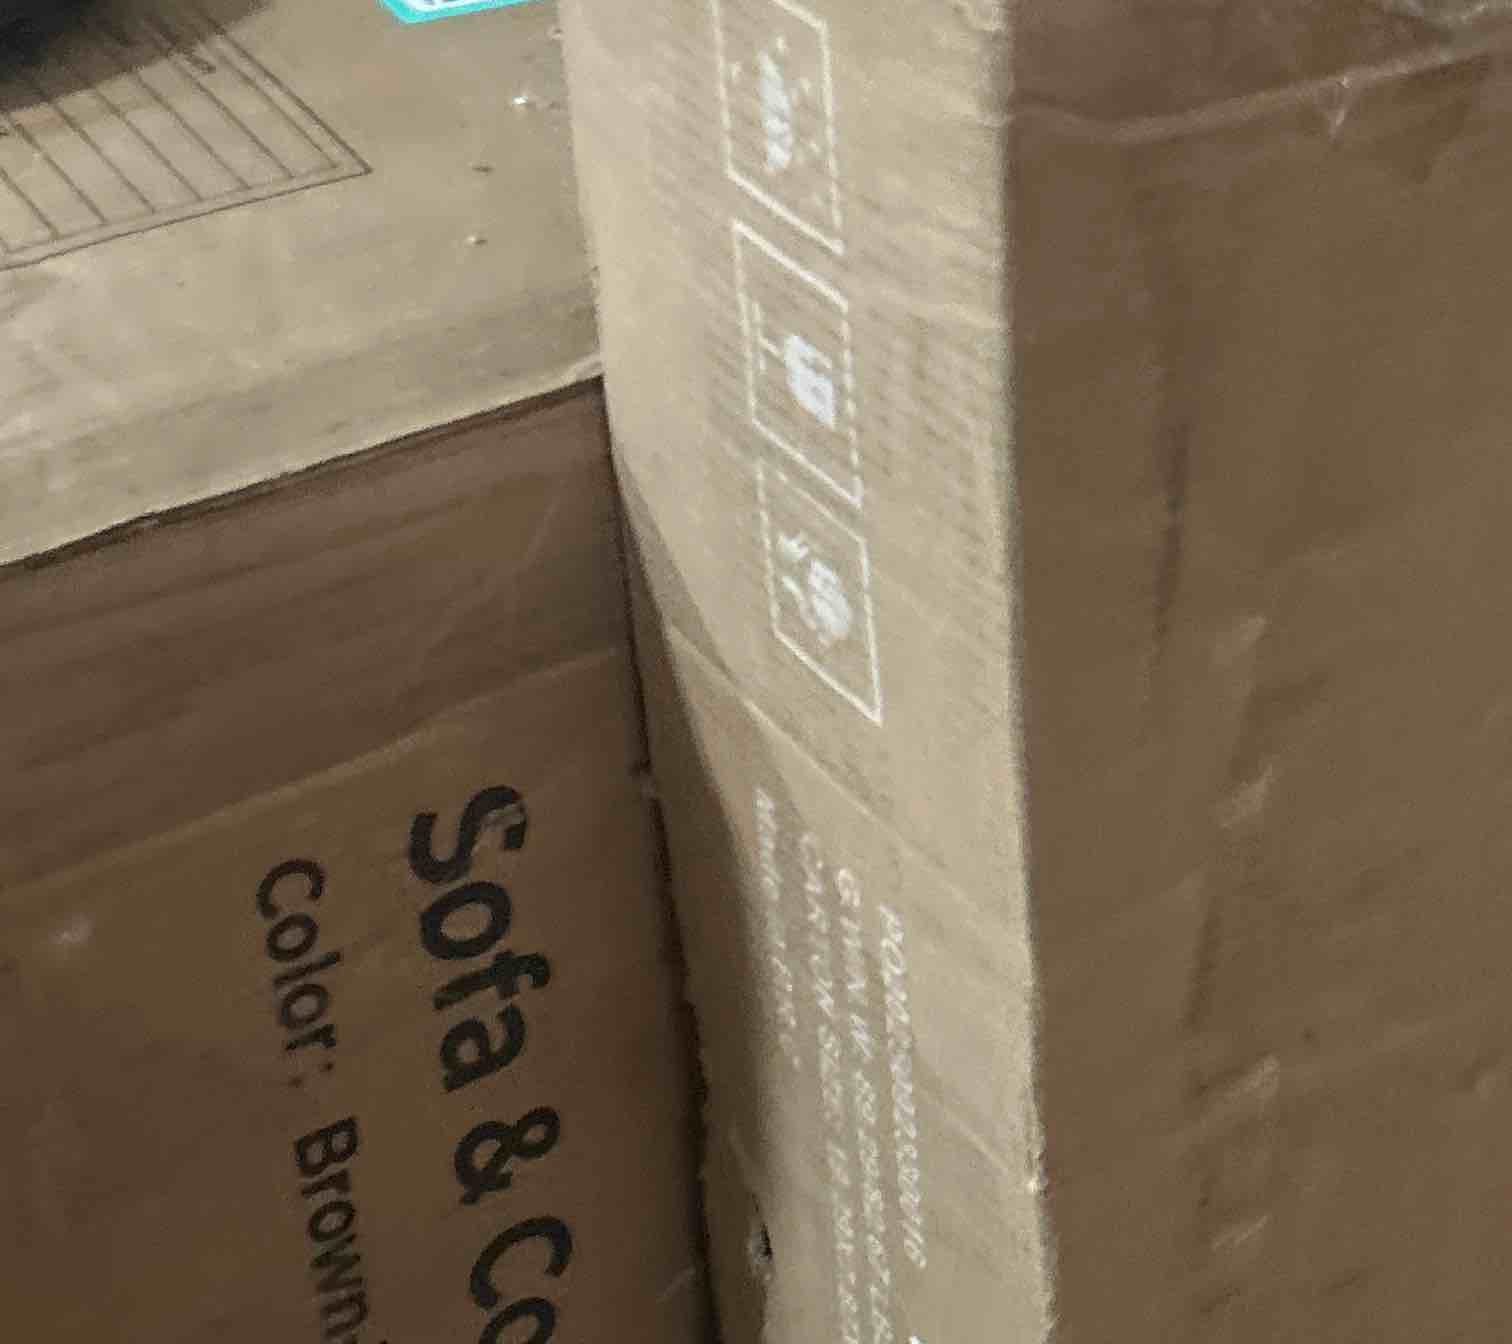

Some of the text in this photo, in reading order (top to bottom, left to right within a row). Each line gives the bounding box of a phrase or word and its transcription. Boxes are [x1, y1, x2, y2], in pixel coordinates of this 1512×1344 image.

[255, 857, 342, 1089] Color:
[408, 785, 551, 1093] Sofa
[454, 1105, 561, 1207] &
